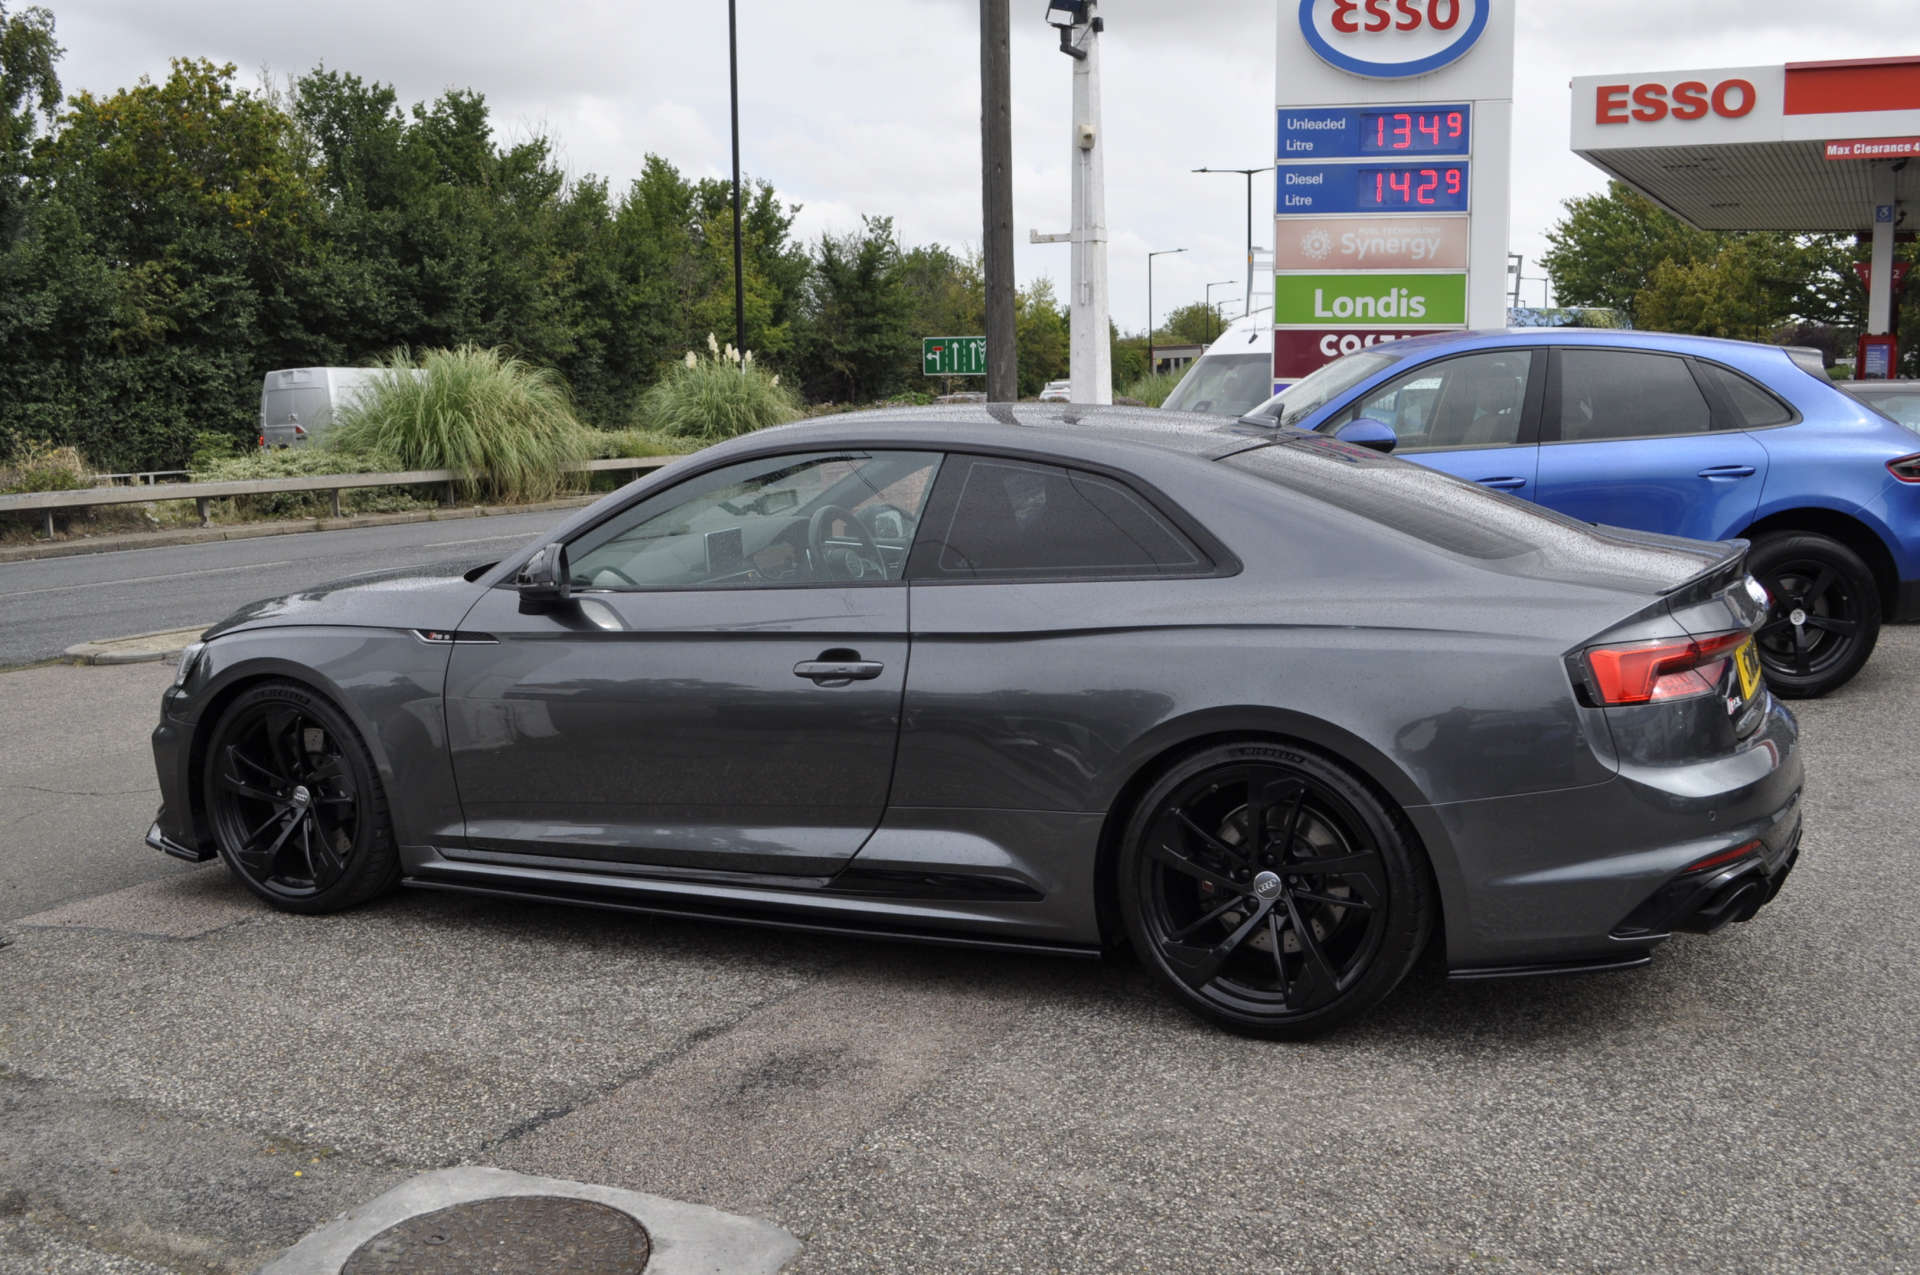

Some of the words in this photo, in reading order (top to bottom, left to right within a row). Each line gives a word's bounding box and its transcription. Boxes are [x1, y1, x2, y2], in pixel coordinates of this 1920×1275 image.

[1596, 78, 1757, 125] ESSO
[1287, 118, 1346, 130] Unleaded
[1286, 139, 1313, 151] Litre
[1827, 145, 1850, 155] Max
[1853, 143, 1911, 154] Clearance
[1285, 173, 1323, 185] Diesel
[1285, 194, 1312, 206] Litre
[1341, 233, 1440, 260] Synergy
[1314, 287, 1426, 318] Londis
